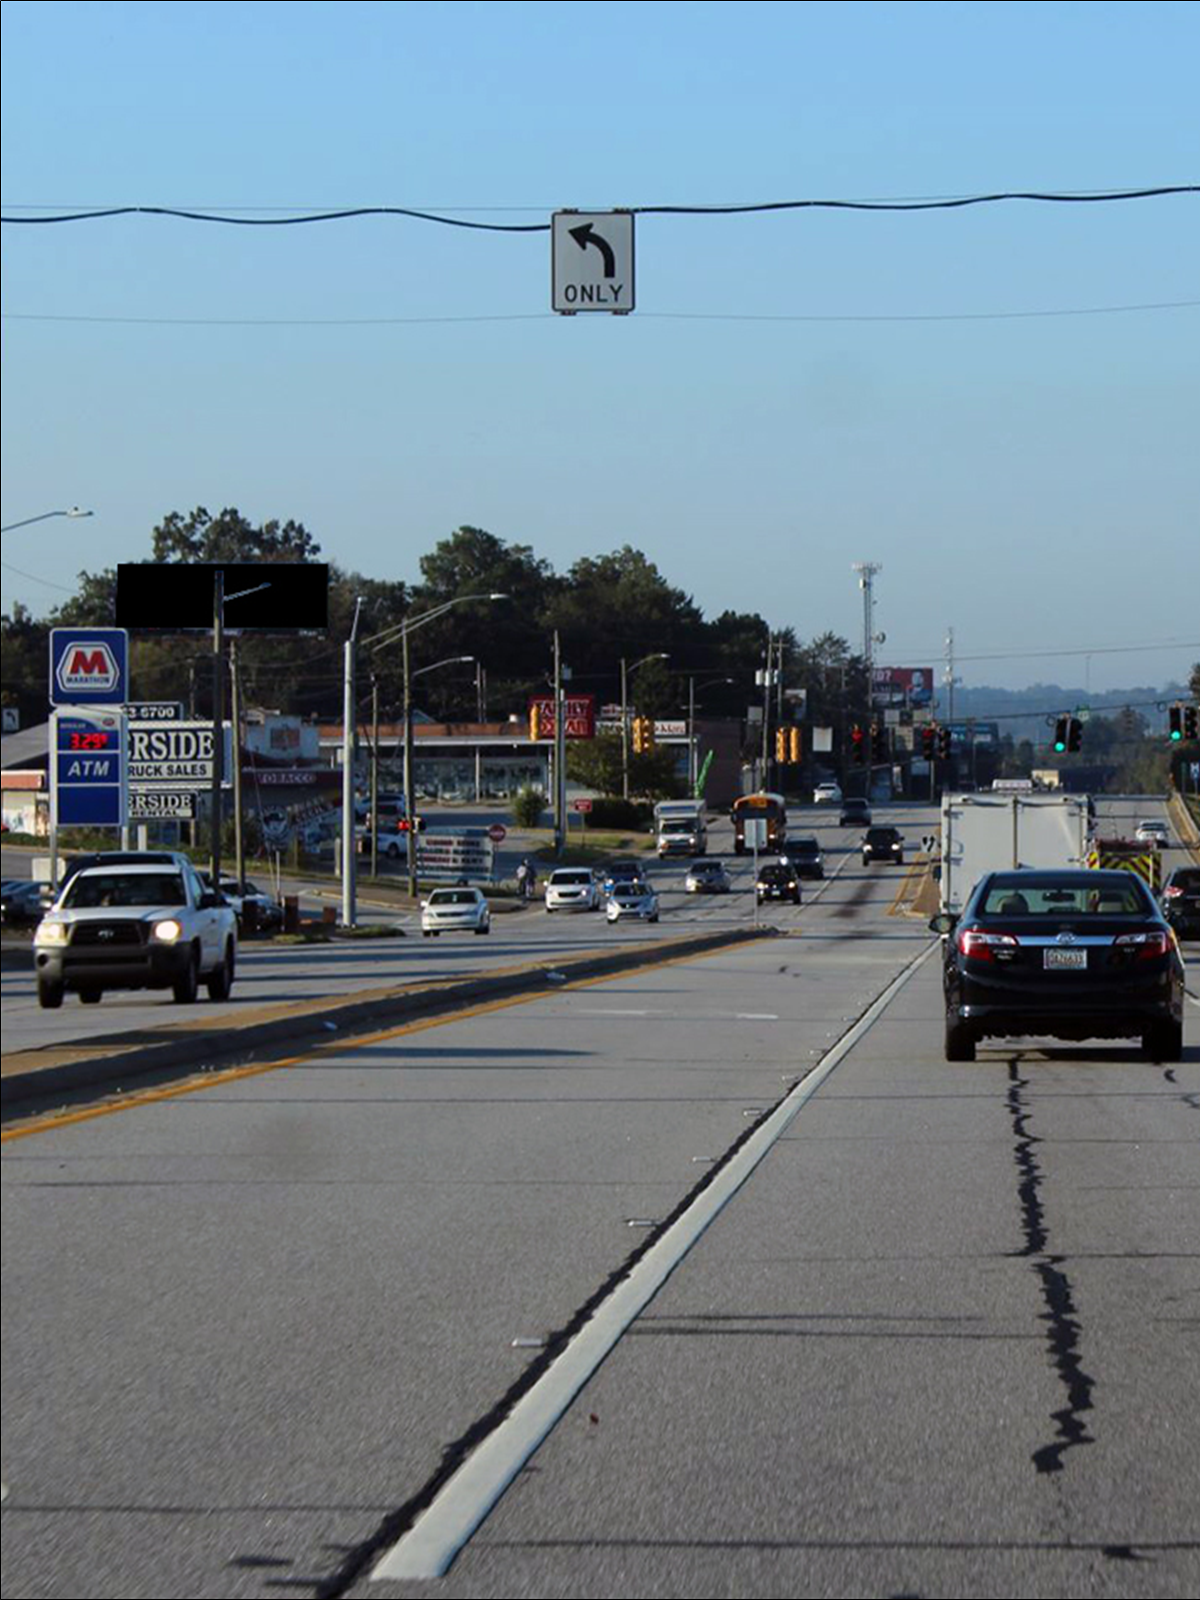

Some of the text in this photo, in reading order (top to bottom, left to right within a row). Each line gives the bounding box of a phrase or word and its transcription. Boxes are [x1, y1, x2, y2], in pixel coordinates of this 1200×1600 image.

[564, 284, 623, 303] ONLY
[69, 649, 109, 675] M
[66, 676, 110, 685] MARATHON
[128, 731, 214, 760] RSIDE
[67, 761, 109, 777] ATM
[128, 764, 207, 776] RUCK SALES
